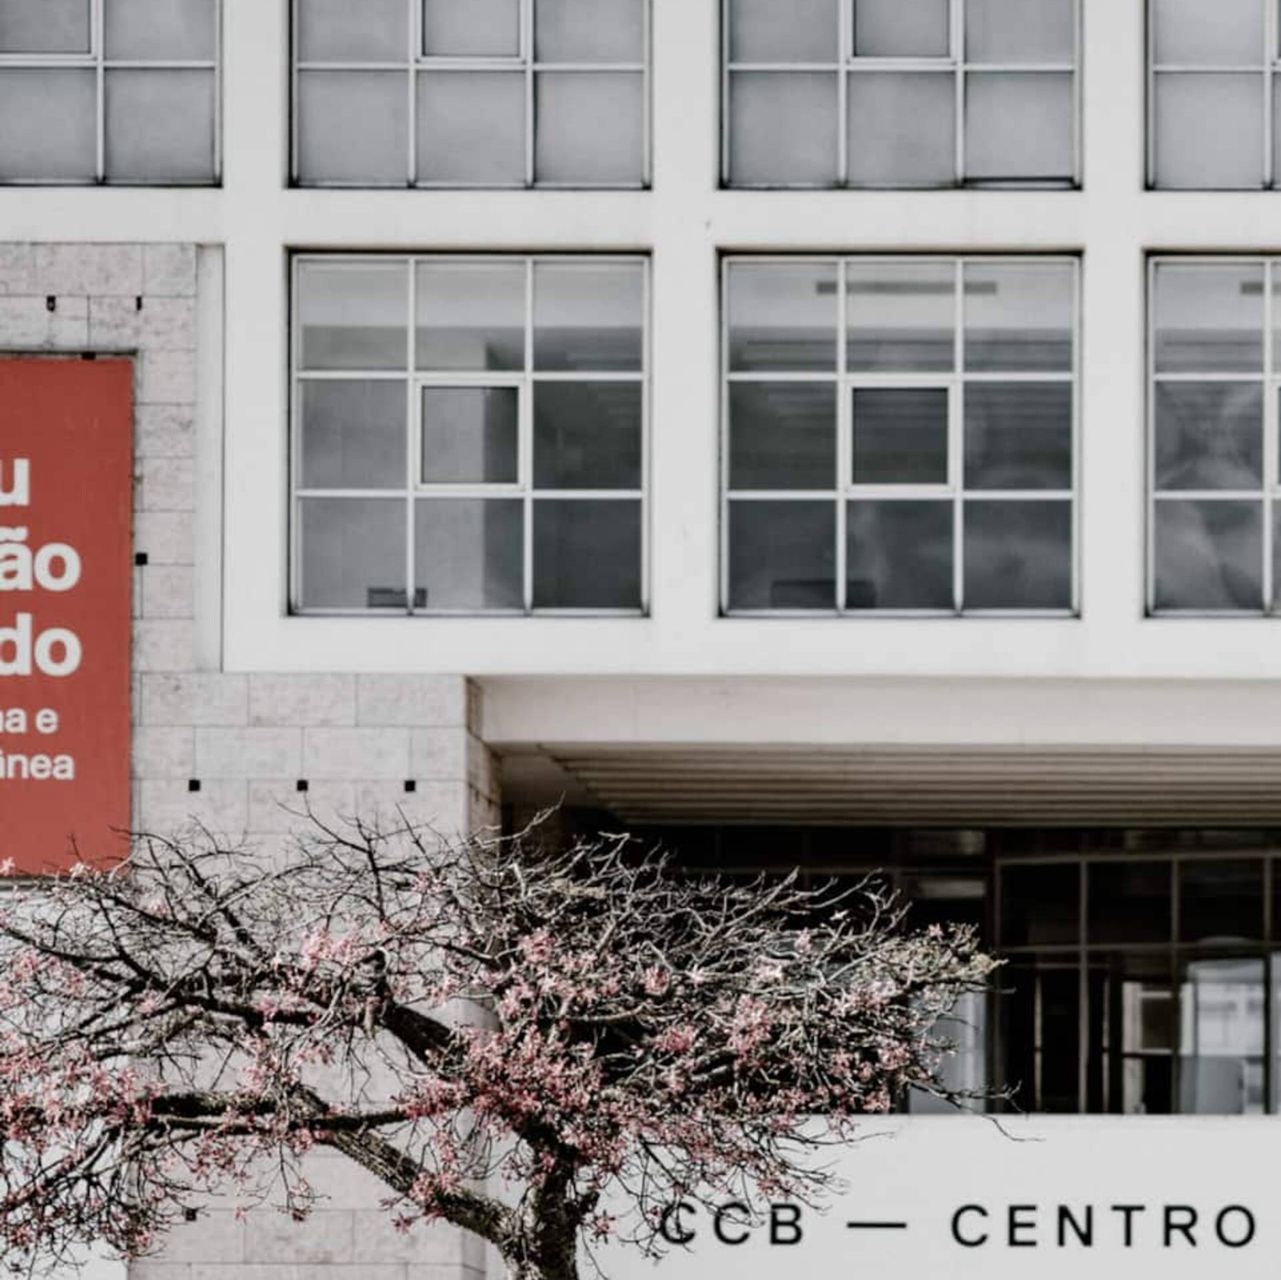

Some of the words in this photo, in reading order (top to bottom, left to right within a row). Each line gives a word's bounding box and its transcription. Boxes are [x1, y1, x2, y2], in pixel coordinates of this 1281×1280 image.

[0, 526, 81, 591] ão
[0, 613, 81, 676] do
[35, 708, 59, 734] e
[0, 749, 75, 780] nea
[660, 1201, 804, 1246] CCB
[951, 1204, 1256, 1248] CENTRO
